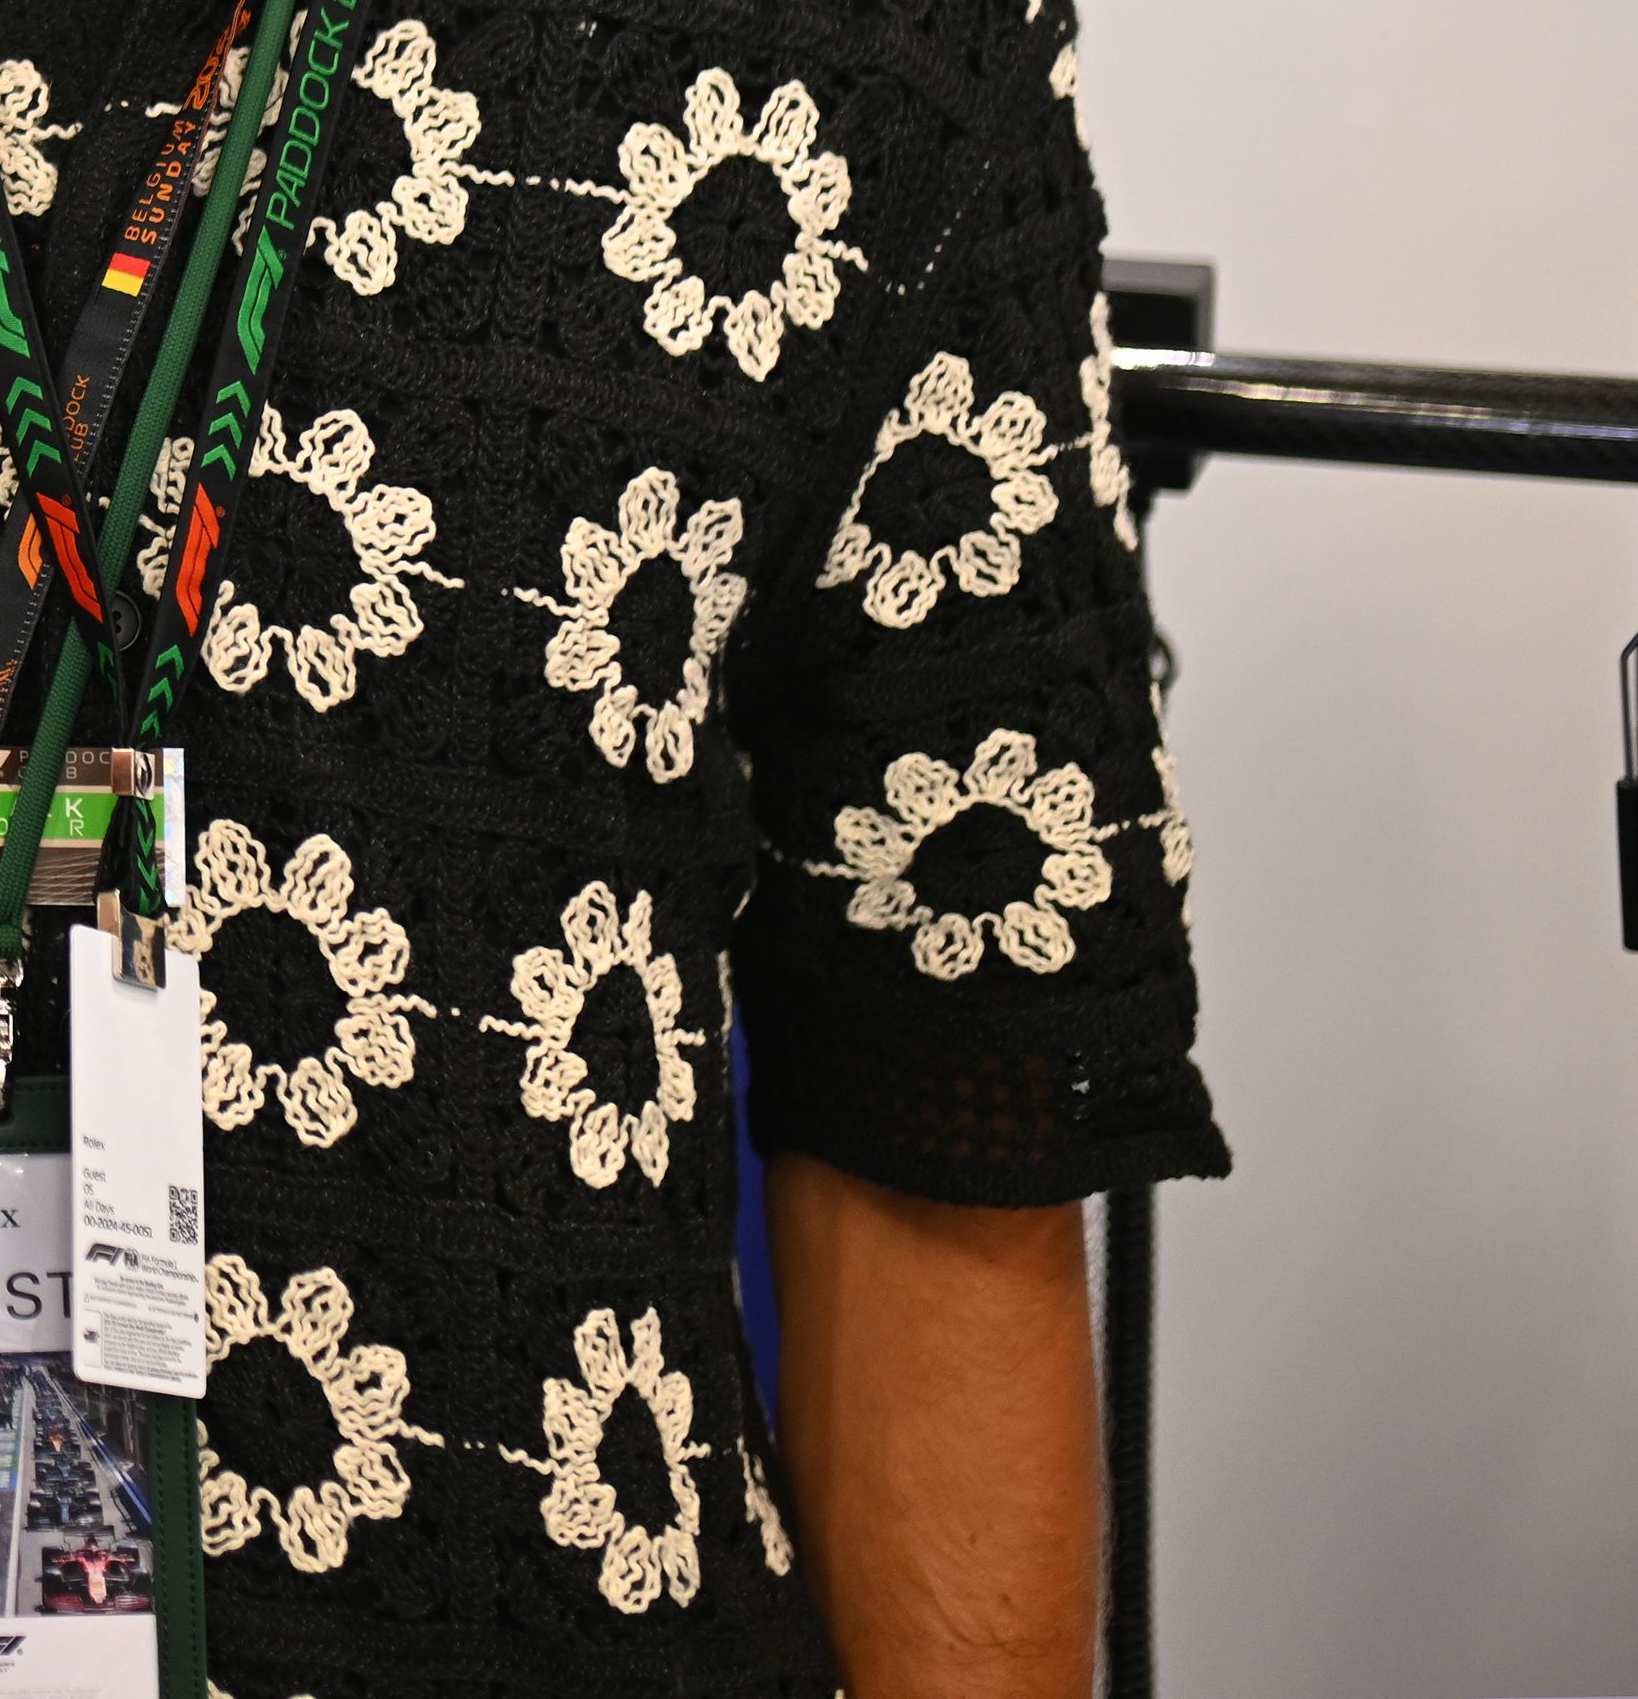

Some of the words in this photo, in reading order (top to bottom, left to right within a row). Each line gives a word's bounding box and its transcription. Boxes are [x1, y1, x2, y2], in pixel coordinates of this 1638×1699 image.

[266, 7, 351, 231] PADDOCK
[124, 119, 185, 241] BELGIUM
[141, 121, 196, 245] SUNDAY
[63, 374, 90, 431] DOCK
[19, 750, 111, 764] PDOC
[83, 1135, 106, 1150] Rolex
[83, 1168, 107, 1182] Guest
